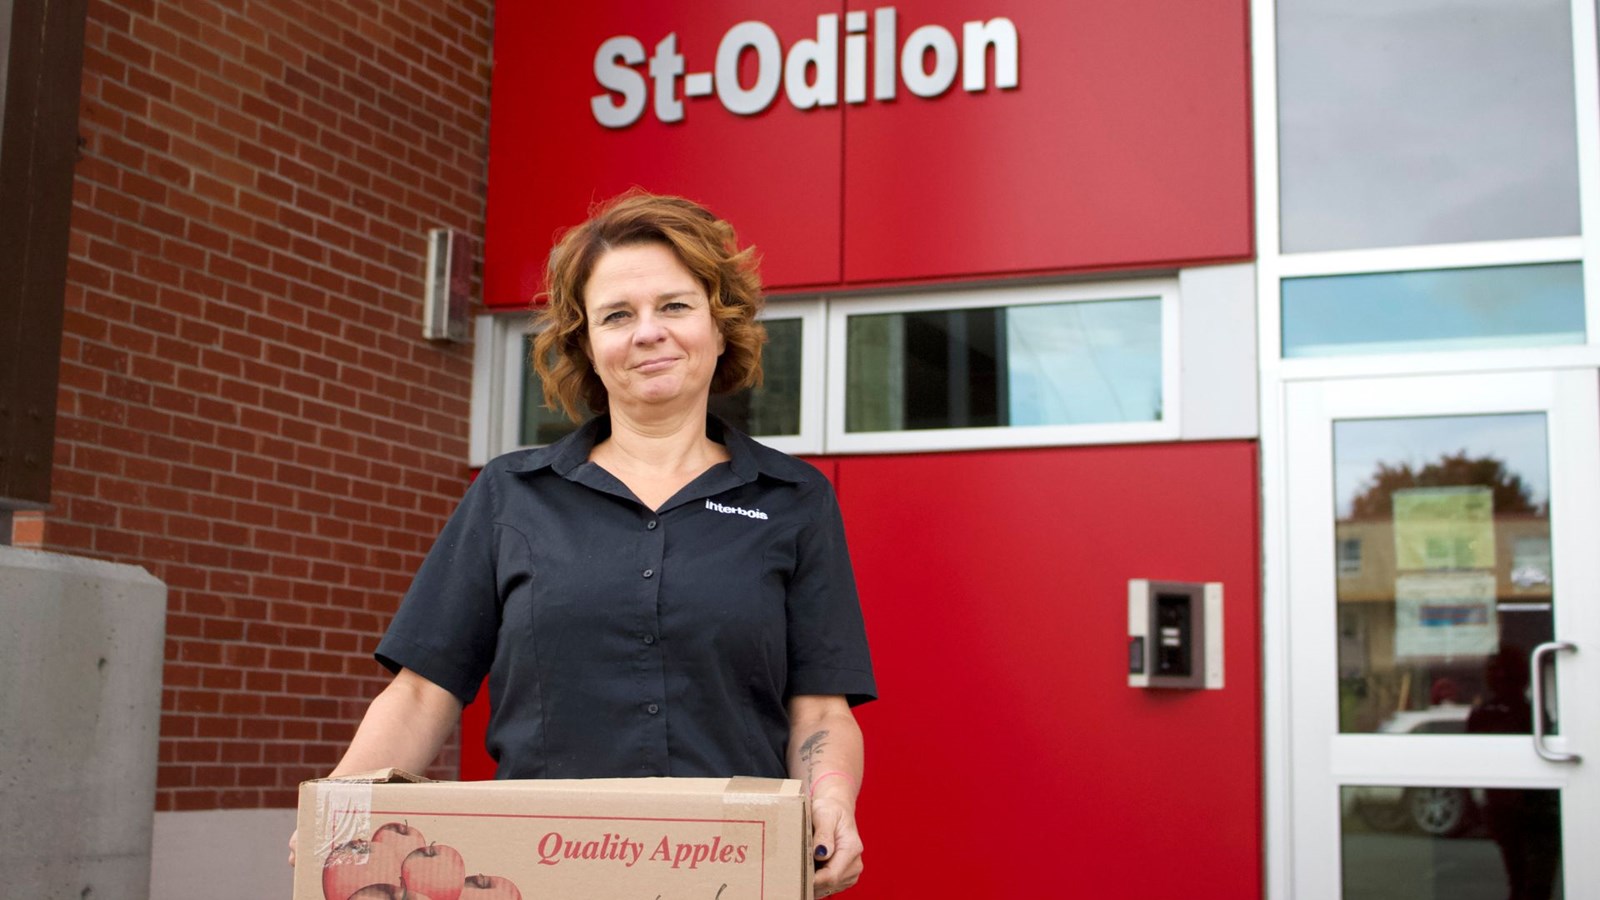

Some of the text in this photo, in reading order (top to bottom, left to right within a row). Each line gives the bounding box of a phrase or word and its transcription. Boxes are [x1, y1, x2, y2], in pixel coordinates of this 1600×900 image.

[590, 7, 1019, 128] St-Odilon
[705, 499, 768, 520] interbois
[537, 832, 748, 869] Quality Apples
